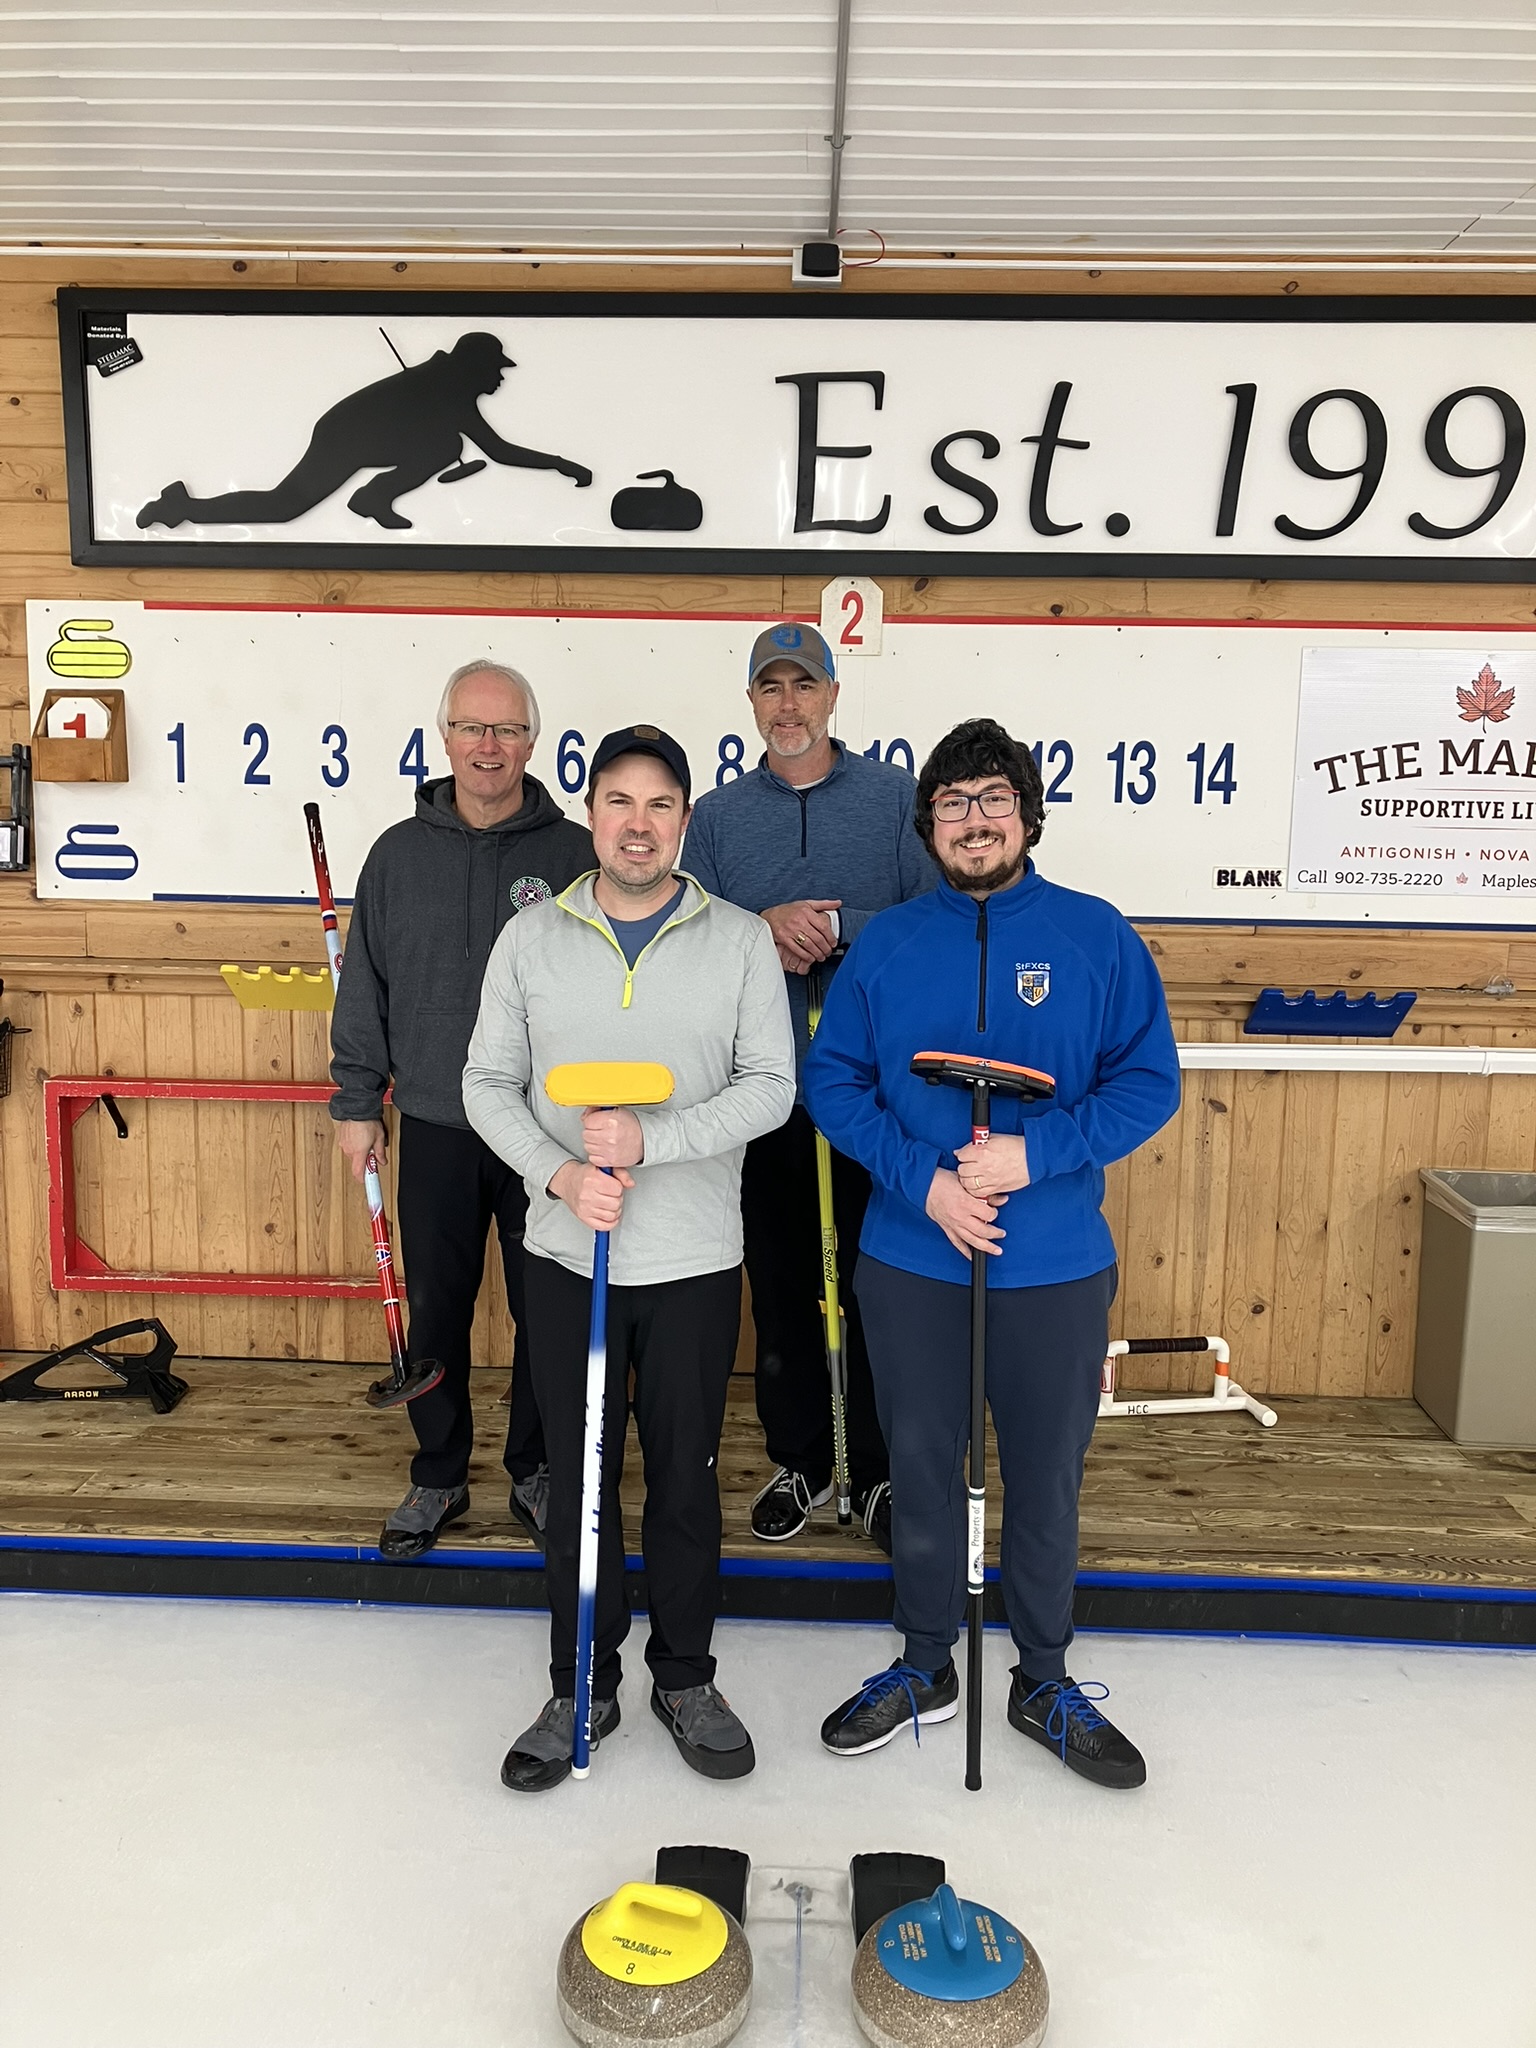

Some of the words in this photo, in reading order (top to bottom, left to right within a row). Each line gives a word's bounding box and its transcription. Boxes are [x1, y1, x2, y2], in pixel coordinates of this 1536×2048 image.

[96, 343, 135, 366] STEELMAC
[774, 369, 1132, 538] Est.
[1214, 381, 1528, 542] 199
[840, 590, 864, 645] 2
[167, 722, 185, 783] 1
[243, 722, 271, 785] 2
[321, 724, 350, 788] 3
[399, 727, 430, 787] 4
[557, 729, 586, 794] 6
[715, 734, 746, 788] 8
[1106, 740, 1157, 805] 13
[1186, 742, 1238, 805] 14
[1313, 741, 1423, 794] THE
[1360, 798, 1505, 820] SUPPORTIVE
[1511, 801, 1536, 820] LI
[1340, 845, 1456, 860] ANTIGONISH
[1479, 849, 1530, 862] NOVA
[1216, 869, 1283, 887] BLANK
[1297, 869, 1328, 885] Call
[1334, 871, 1443, 887] 902-735-2220
[1015, 962, 1051, 971] StFXCS
[64, 1390, 99, 1399] ARROW
[1127, 1404, 1149, 1415] HCC
[971, 1505, 981, 1515] of
[971, 1516, 982, 1547] Property
[883, 1939, 895, 1948] 8
[1005, 1935, 1017, 1944] 8
[625, 1962, 636, 1975] 8
